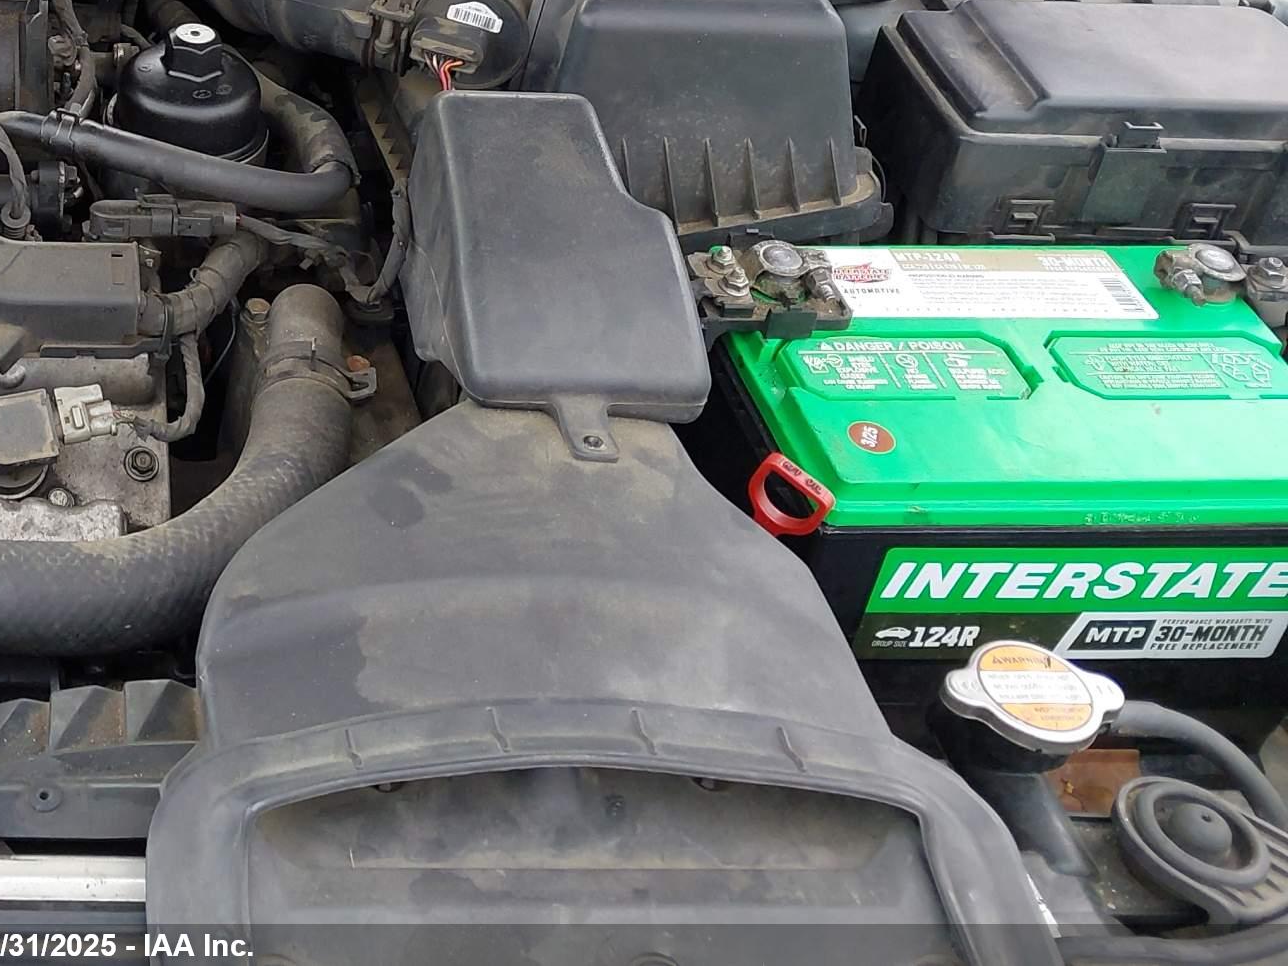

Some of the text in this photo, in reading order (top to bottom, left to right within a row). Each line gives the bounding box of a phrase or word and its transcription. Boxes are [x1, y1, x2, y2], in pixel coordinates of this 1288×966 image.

[833, 341, 893, 352] DANGER
[909, 341, 965, 351] POISON
[860, 426, 879, 448] 3/25
[880, 561, 1288, 600] INTERSTATE
[908, 625, 981, 648] 124R
[1085, 625, 1272, 644] MTP 30-MONTH
[1150, 642, 1262, 651] FREE REPLACEMENT
